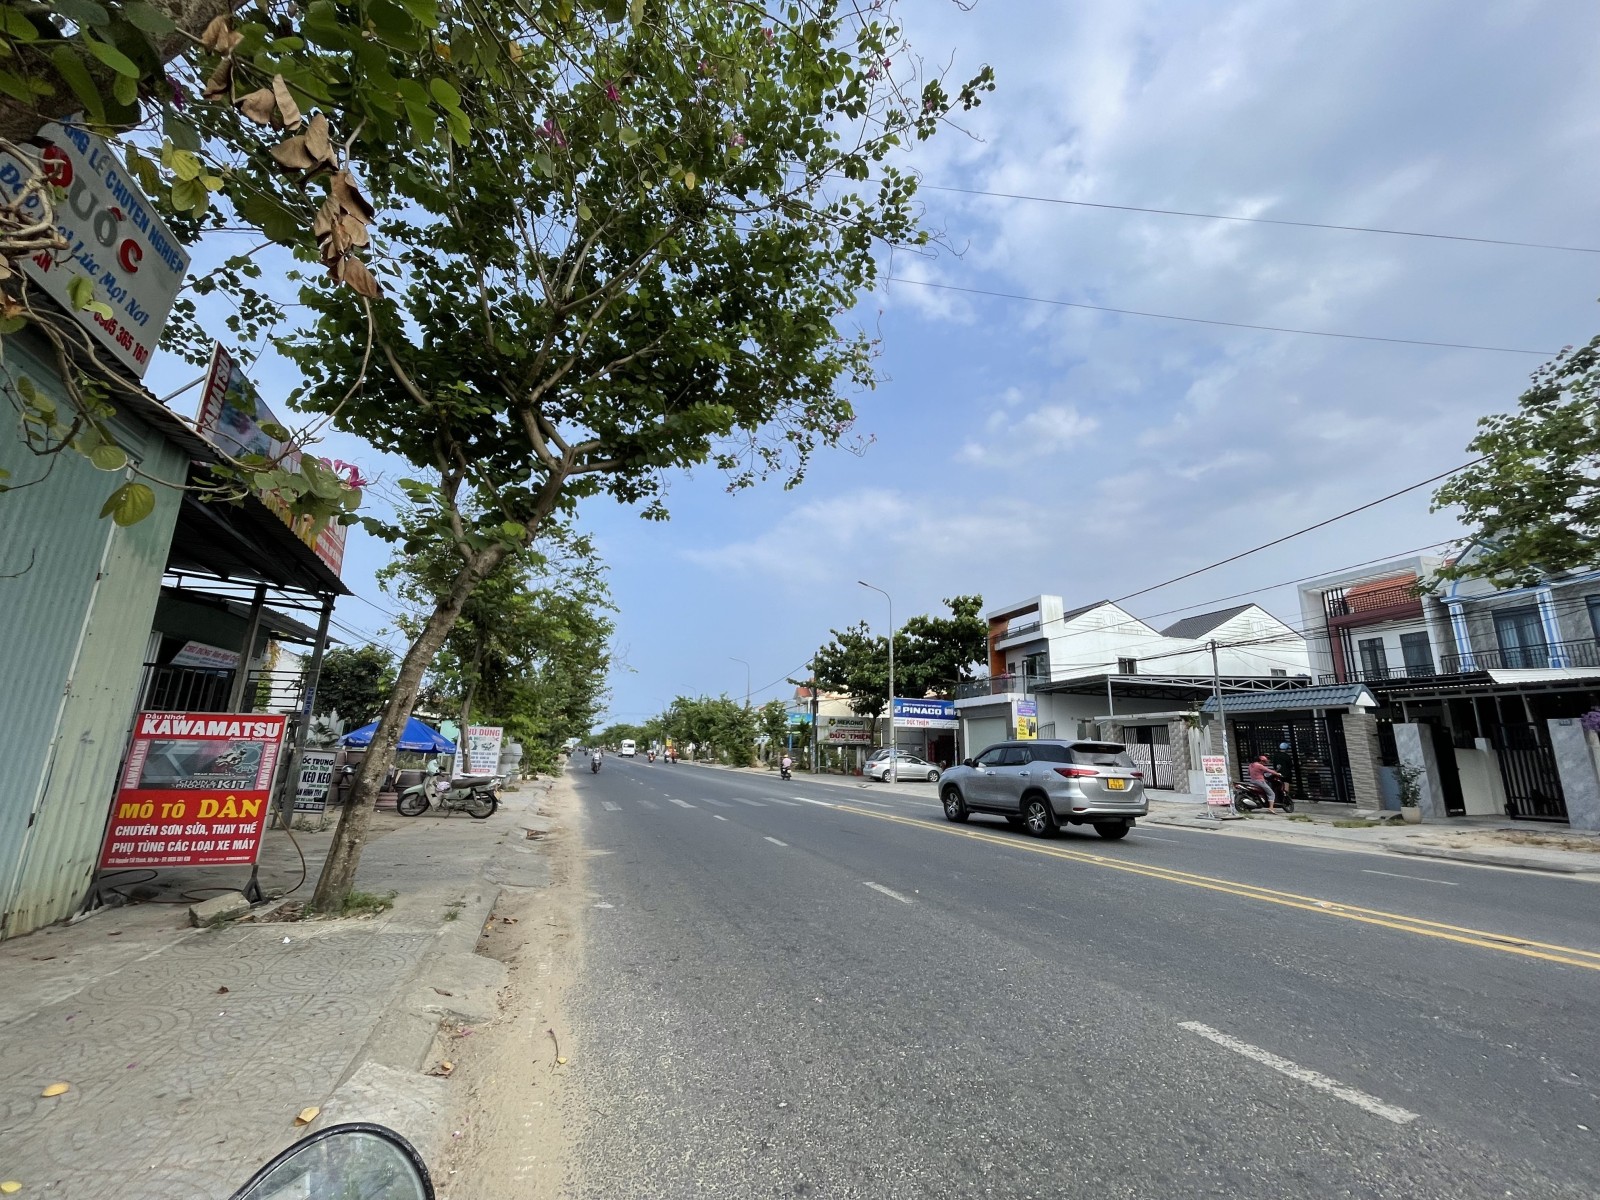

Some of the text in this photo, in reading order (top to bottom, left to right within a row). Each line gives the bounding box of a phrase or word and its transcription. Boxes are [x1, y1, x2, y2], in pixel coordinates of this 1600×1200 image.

[902, 706, 942, 716] PINACO
[140, 719, 280, 738] KAWAMATSU
[124, 740, 148, 789] KAWAMATSU
[256, 744, 277, 790] KAWAMATSU
[312, 758, 334, 766] TRUNG
[217, 780, 250, 789] KIT
[118, 795, 263, 819] MÔ TÔ DÂN
[115, 820, 259, 836] CHUYÊN SƠN SỬA, THAY THẾ
[111, 837, 256, 855] PHỤ TÙNG CÁC LOẠI XE MÁY
